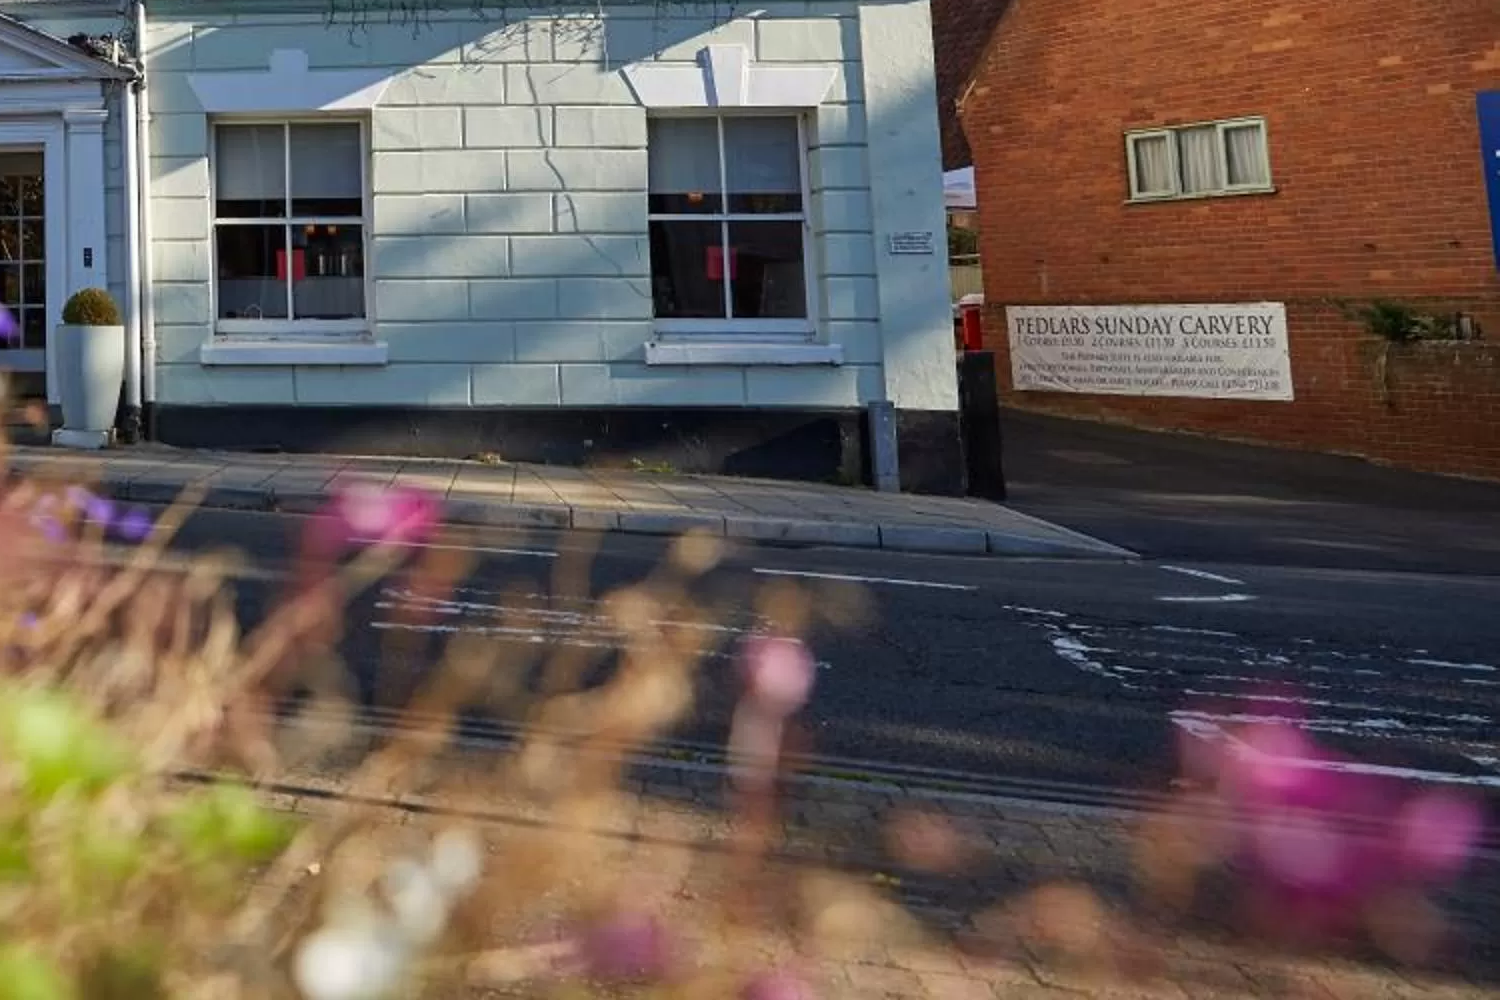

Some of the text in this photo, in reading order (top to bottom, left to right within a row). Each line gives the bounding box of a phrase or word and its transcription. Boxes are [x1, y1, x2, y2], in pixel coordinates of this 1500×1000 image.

[1015, 314, 1274, 335] PEDLARS SUNDAY CARVERY
